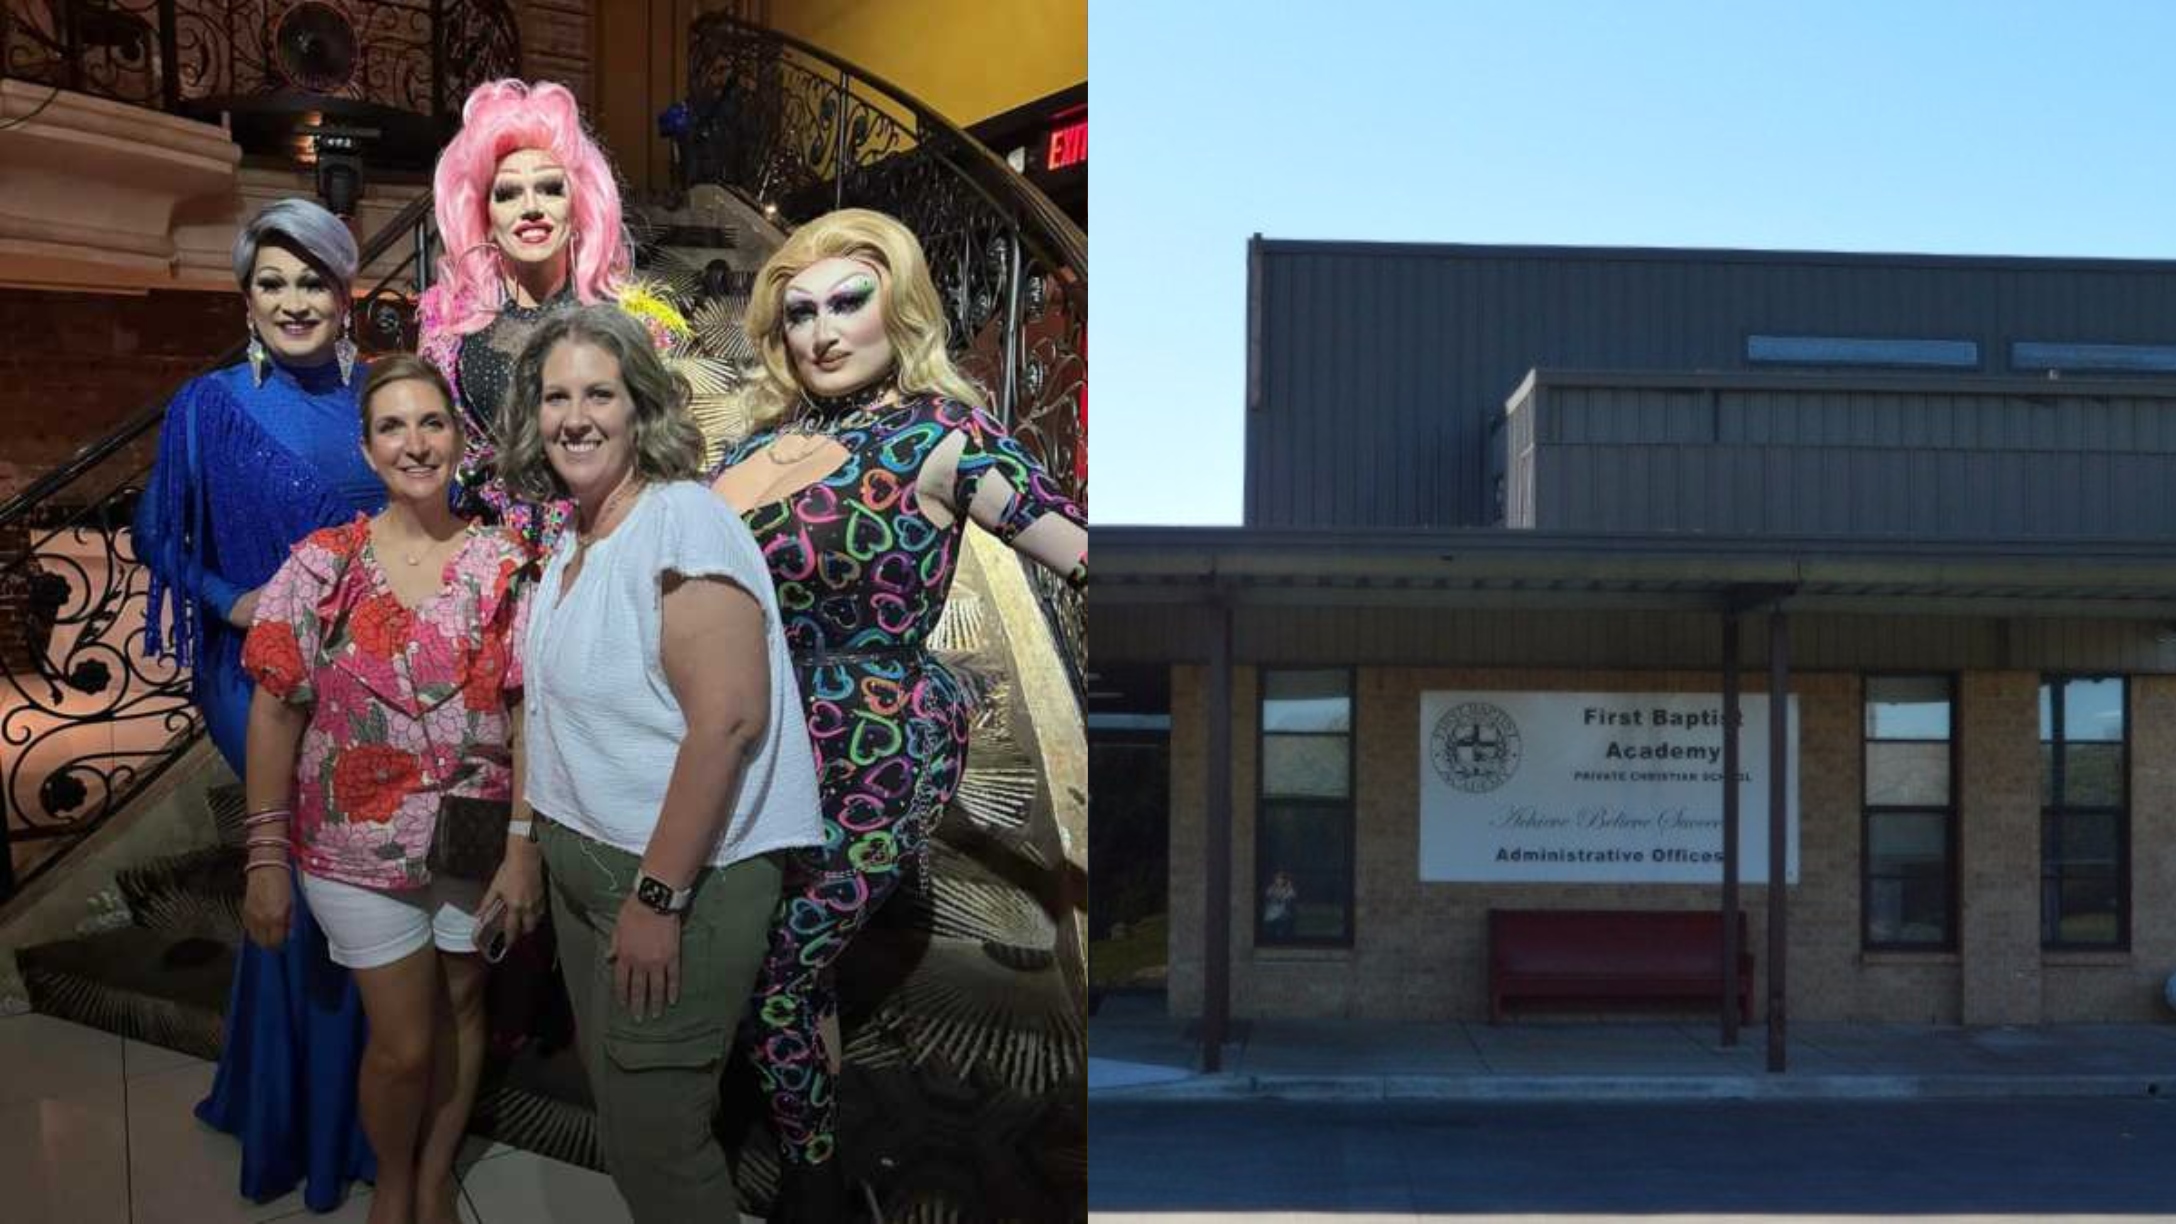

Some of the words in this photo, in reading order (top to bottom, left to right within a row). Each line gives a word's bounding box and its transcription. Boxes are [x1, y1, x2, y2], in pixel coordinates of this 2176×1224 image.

[1583, 707, 1643, 726] First
[1651, 707, 1744, 731] Baptit
[1606, 741, 1721, 765] Academy
[1573, 770, 1627, 781] PRIVATE
[1630, 770, 1698, 782] CHRISTIAN
[1702, 770, 1753, 782] SCHOL
[1495, 846, 1644, 863] Administrative
[1651, 847, 1724, 863] Offices
